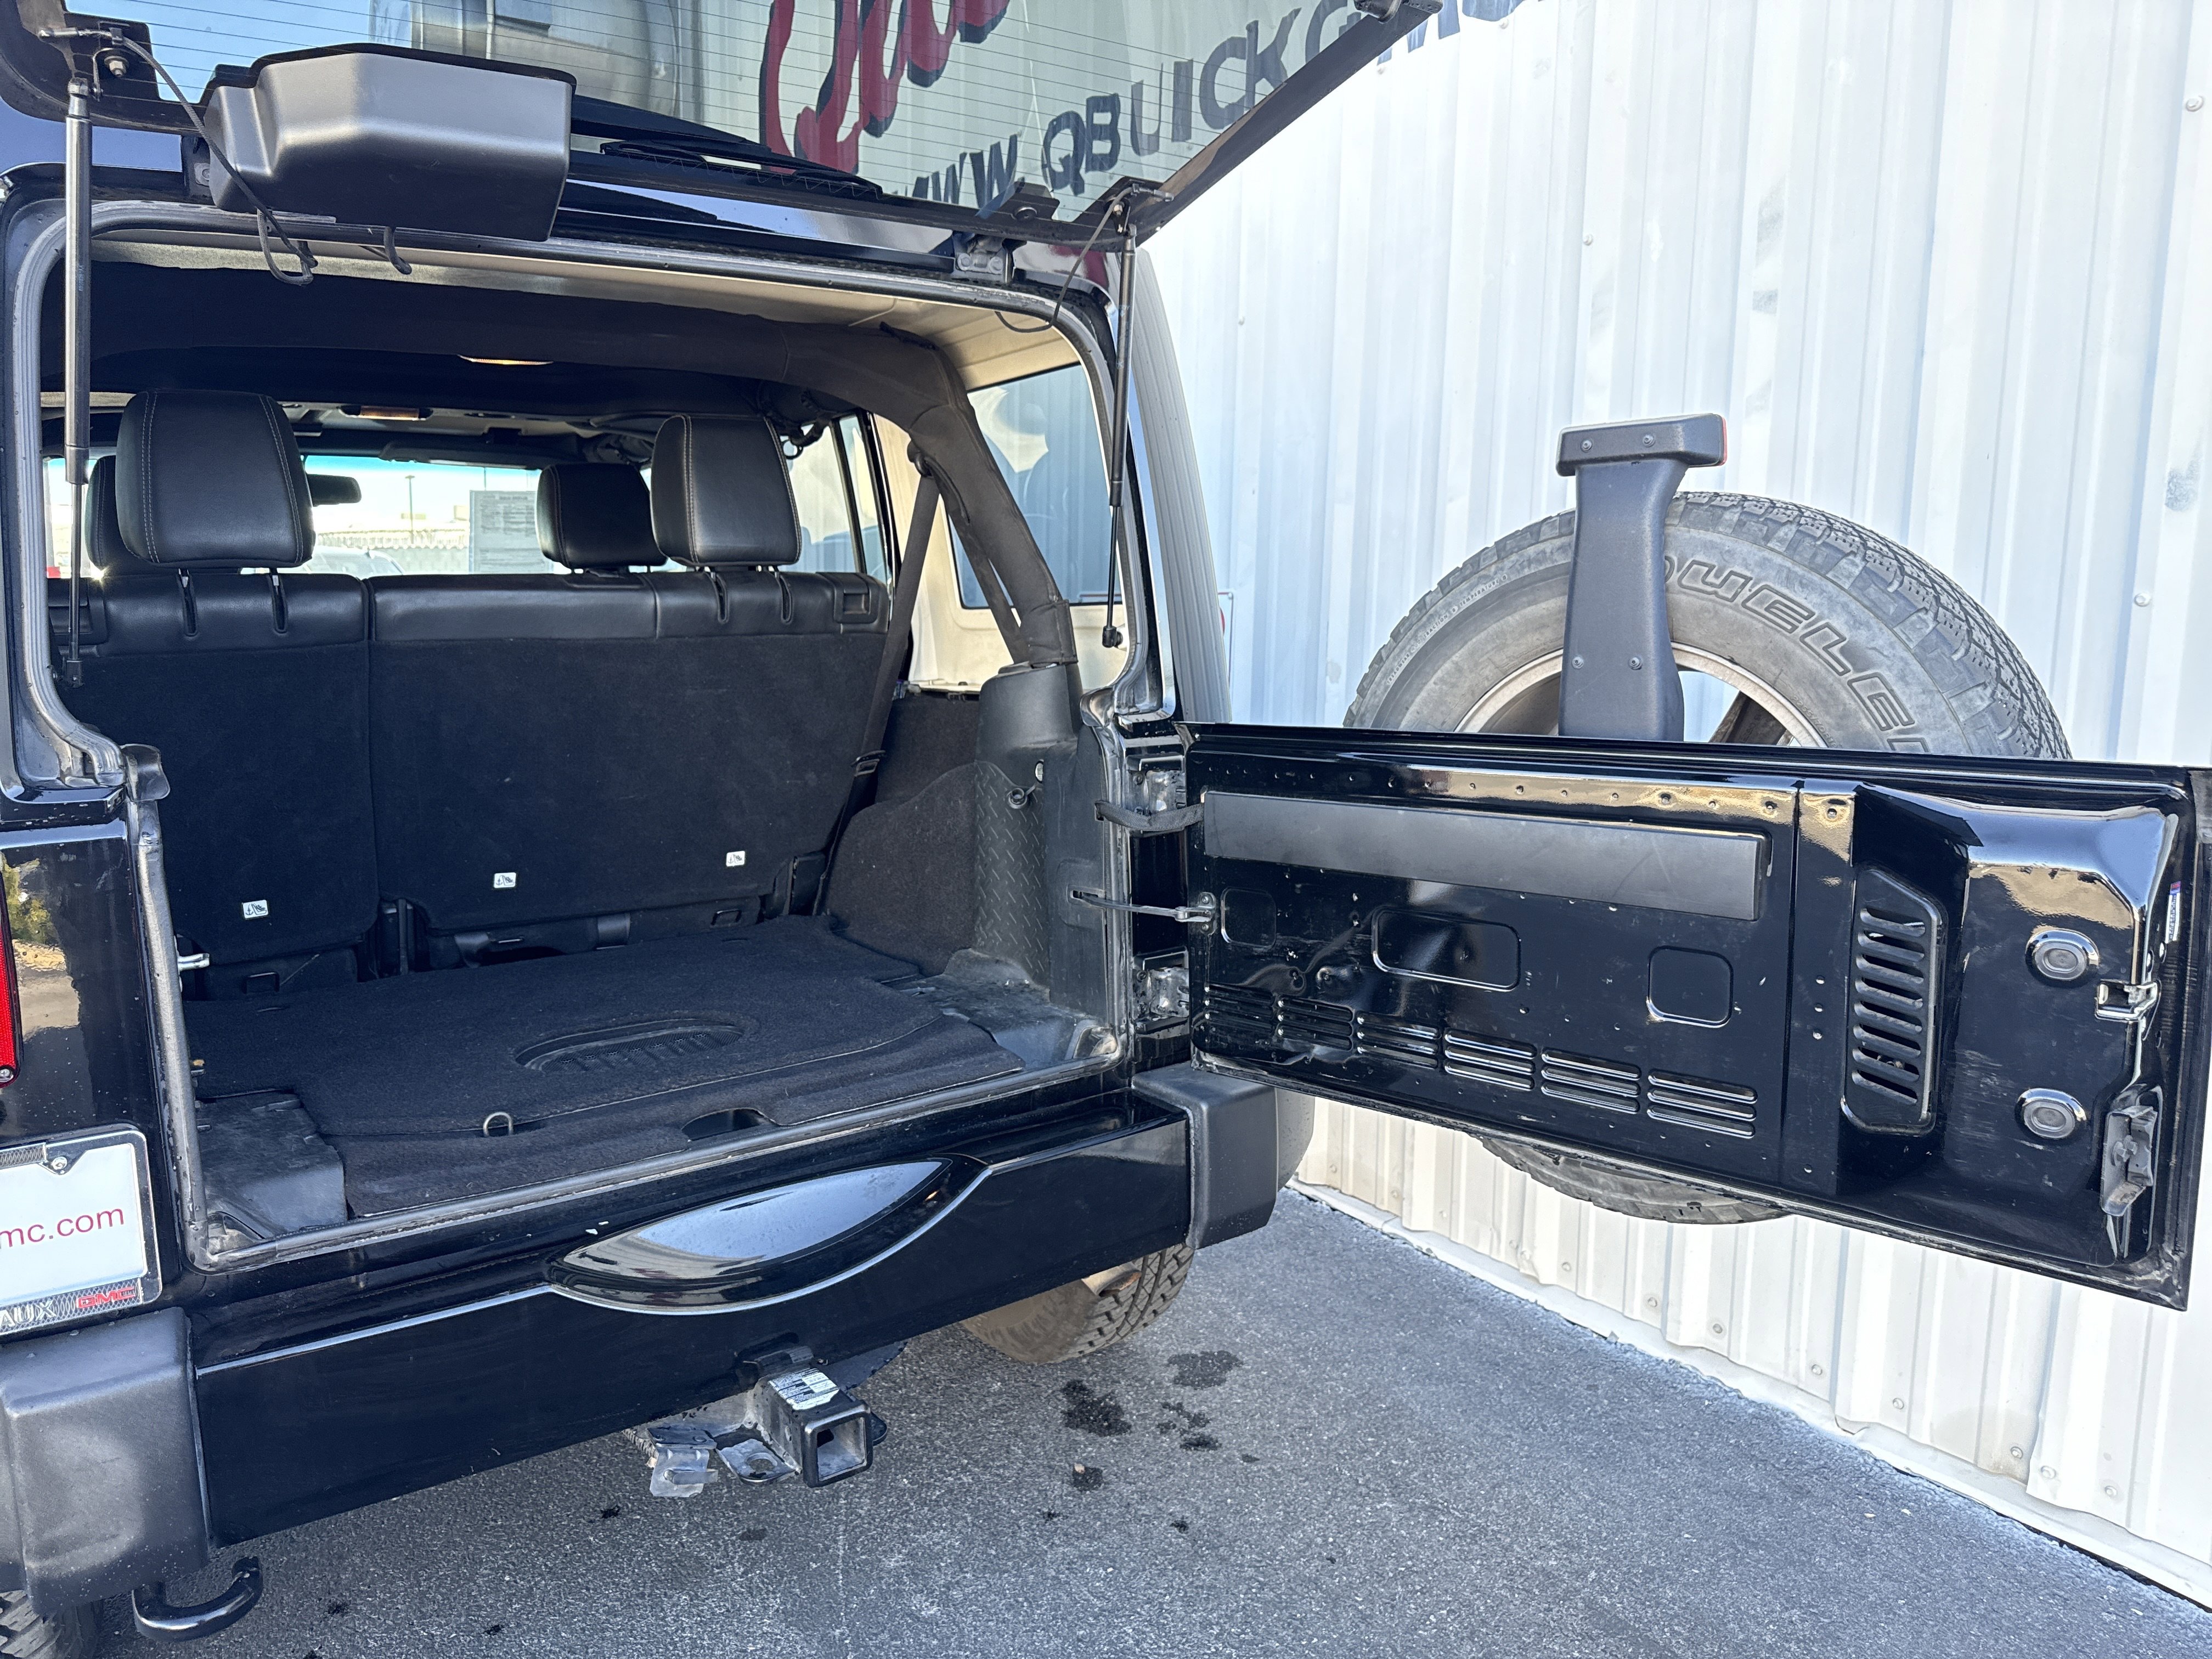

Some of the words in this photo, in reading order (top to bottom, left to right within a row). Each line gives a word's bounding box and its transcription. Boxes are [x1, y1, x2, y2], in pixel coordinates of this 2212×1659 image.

[892, 134, 1018, 208] WW
[1424, 614, 1448, 638] TRACTION
[1459, 578, 1499, 607] TEMPERATURE
[1664, 556, 1930, 753] UELE
[76, 1286, 136, 1309] GMC
